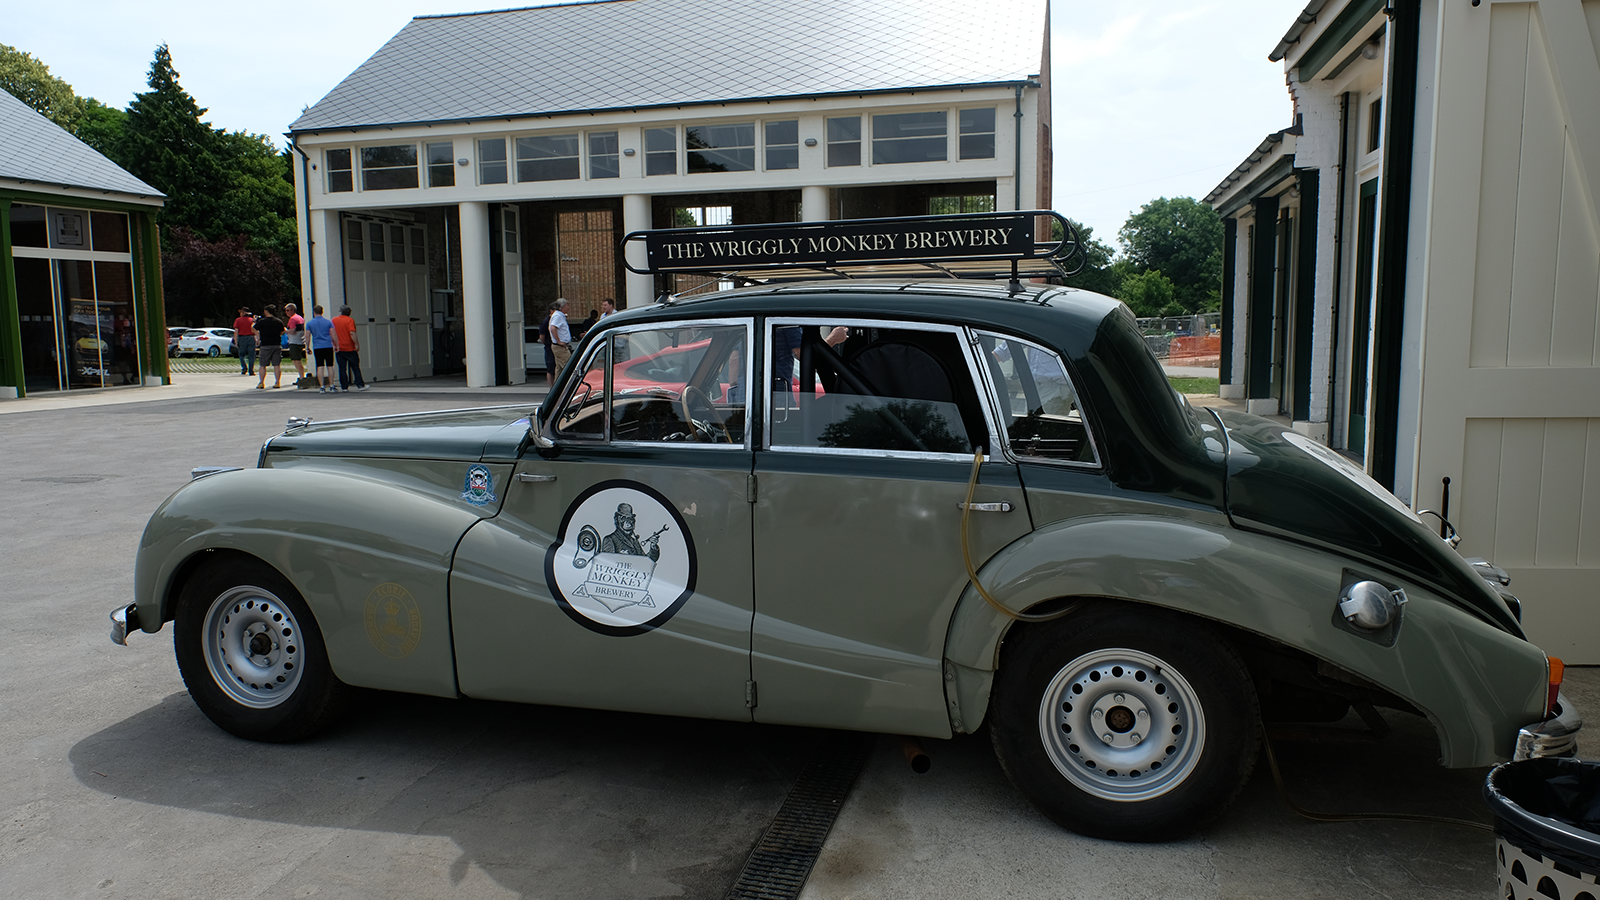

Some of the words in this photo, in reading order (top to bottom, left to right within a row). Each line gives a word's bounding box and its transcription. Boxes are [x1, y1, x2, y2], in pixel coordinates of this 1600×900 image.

[662, 242, 706, 259] THE
[708, 238, 803, 257] WRIGGLY
[808, 233, 899, 253] MONKEY
[904, 227, 1013, 250] BREWERY
[595, 564, 650, 580] WRIGGLY
[615, 561, 632, 570] THE
[591, 572, 645, 587] MONKEY
[376, 585, 407, 600] ECURIE
[595, 586, 636, 599] BREWERY
